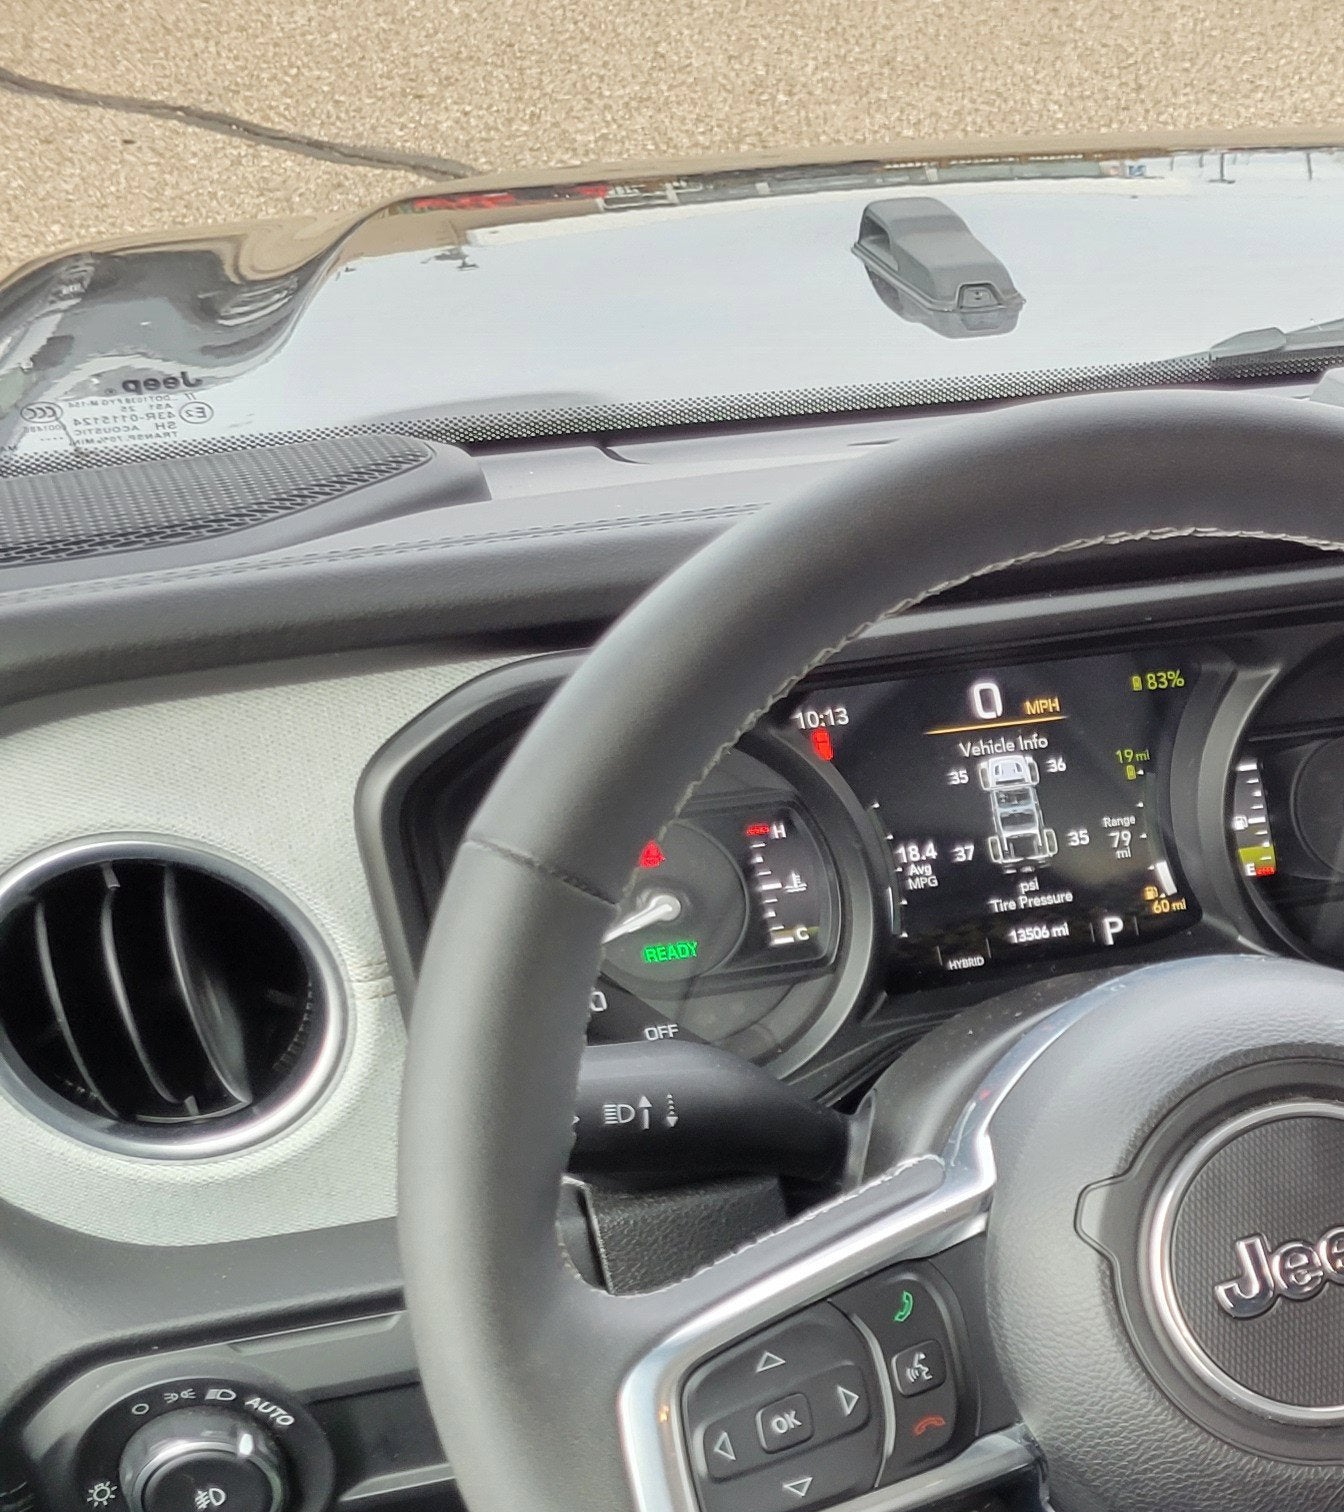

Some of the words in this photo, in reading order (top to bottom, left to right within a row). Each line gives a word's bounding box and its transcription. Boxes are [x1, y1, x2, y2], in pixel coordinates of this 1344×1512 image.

[1146, 669, 1185, 690] 83%
[1025, 697, 1060, 715] MPH
[794, 707, 849, 729] 10:13
[959, 738, 1015, 758] Vehicle
[1019, 735, 1049, 752] Info
[1116, 749, 1133, 763] 19
[1135, 748, 1150, 761] mi
[1047, 757, 1067, 773] 36
[949, 771, 969, 785] 35
[771, 823, 787, 838] H
[1103, 815, 1136, 829] Range
[1067, 830, 1090, 847] 35
[1108, 831, 1131, 848] 79
[896, 842, 938, 863] 18.4
[952, 844, 975, 862] 37
[1116, 847, 1132, 859] mi
[908, 863, 932, 876] Avg
[907, 876, 938, 890] MPG
[1018, 877, 1040, 893] psi
[988, 897, 1017, 913] Tire
[1019, 891, 1073, 910] Pressure
[1152, 900, 1170, 914] 60
[1171, 899, 1187, 911] mi
[796, 926, 810, 941] C
[1008, 925, 1050, 944] 13506
[1052, 922, 1070, 938] mi
[1103, 916, 1124, 945] P
[643, 941, 699, 963] READY
[947, 955, 985, 970] HYBRID
[644, 1023, 679, 1041] OFF
[244, 1396, 295, 1428] AUTO
[770, 1409, 802, 1435] OK
